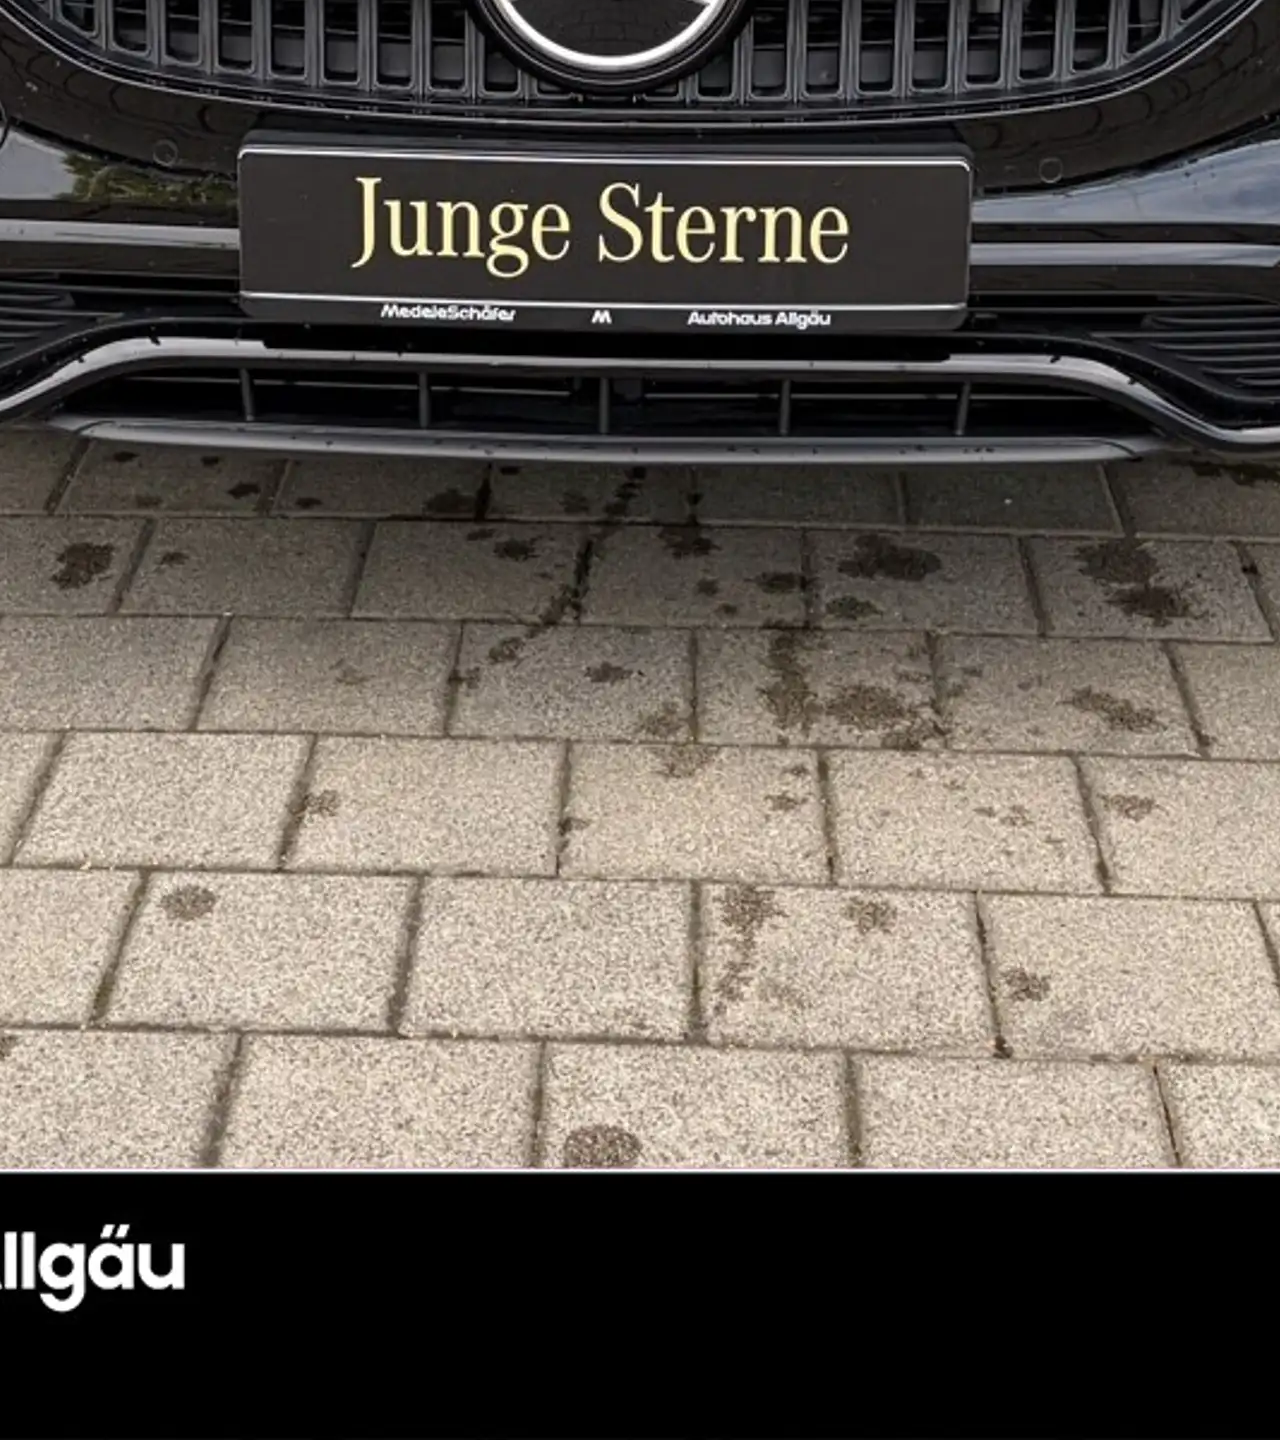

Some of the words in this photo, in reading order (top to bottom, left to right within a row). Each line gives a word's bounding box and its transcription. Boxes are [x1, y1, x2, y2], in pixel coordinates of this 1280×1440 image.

[351, 177, 570, 278] Junge
[598, 182, 849, 264] Sterne
[687, 310, 772, 326] Autohaus
